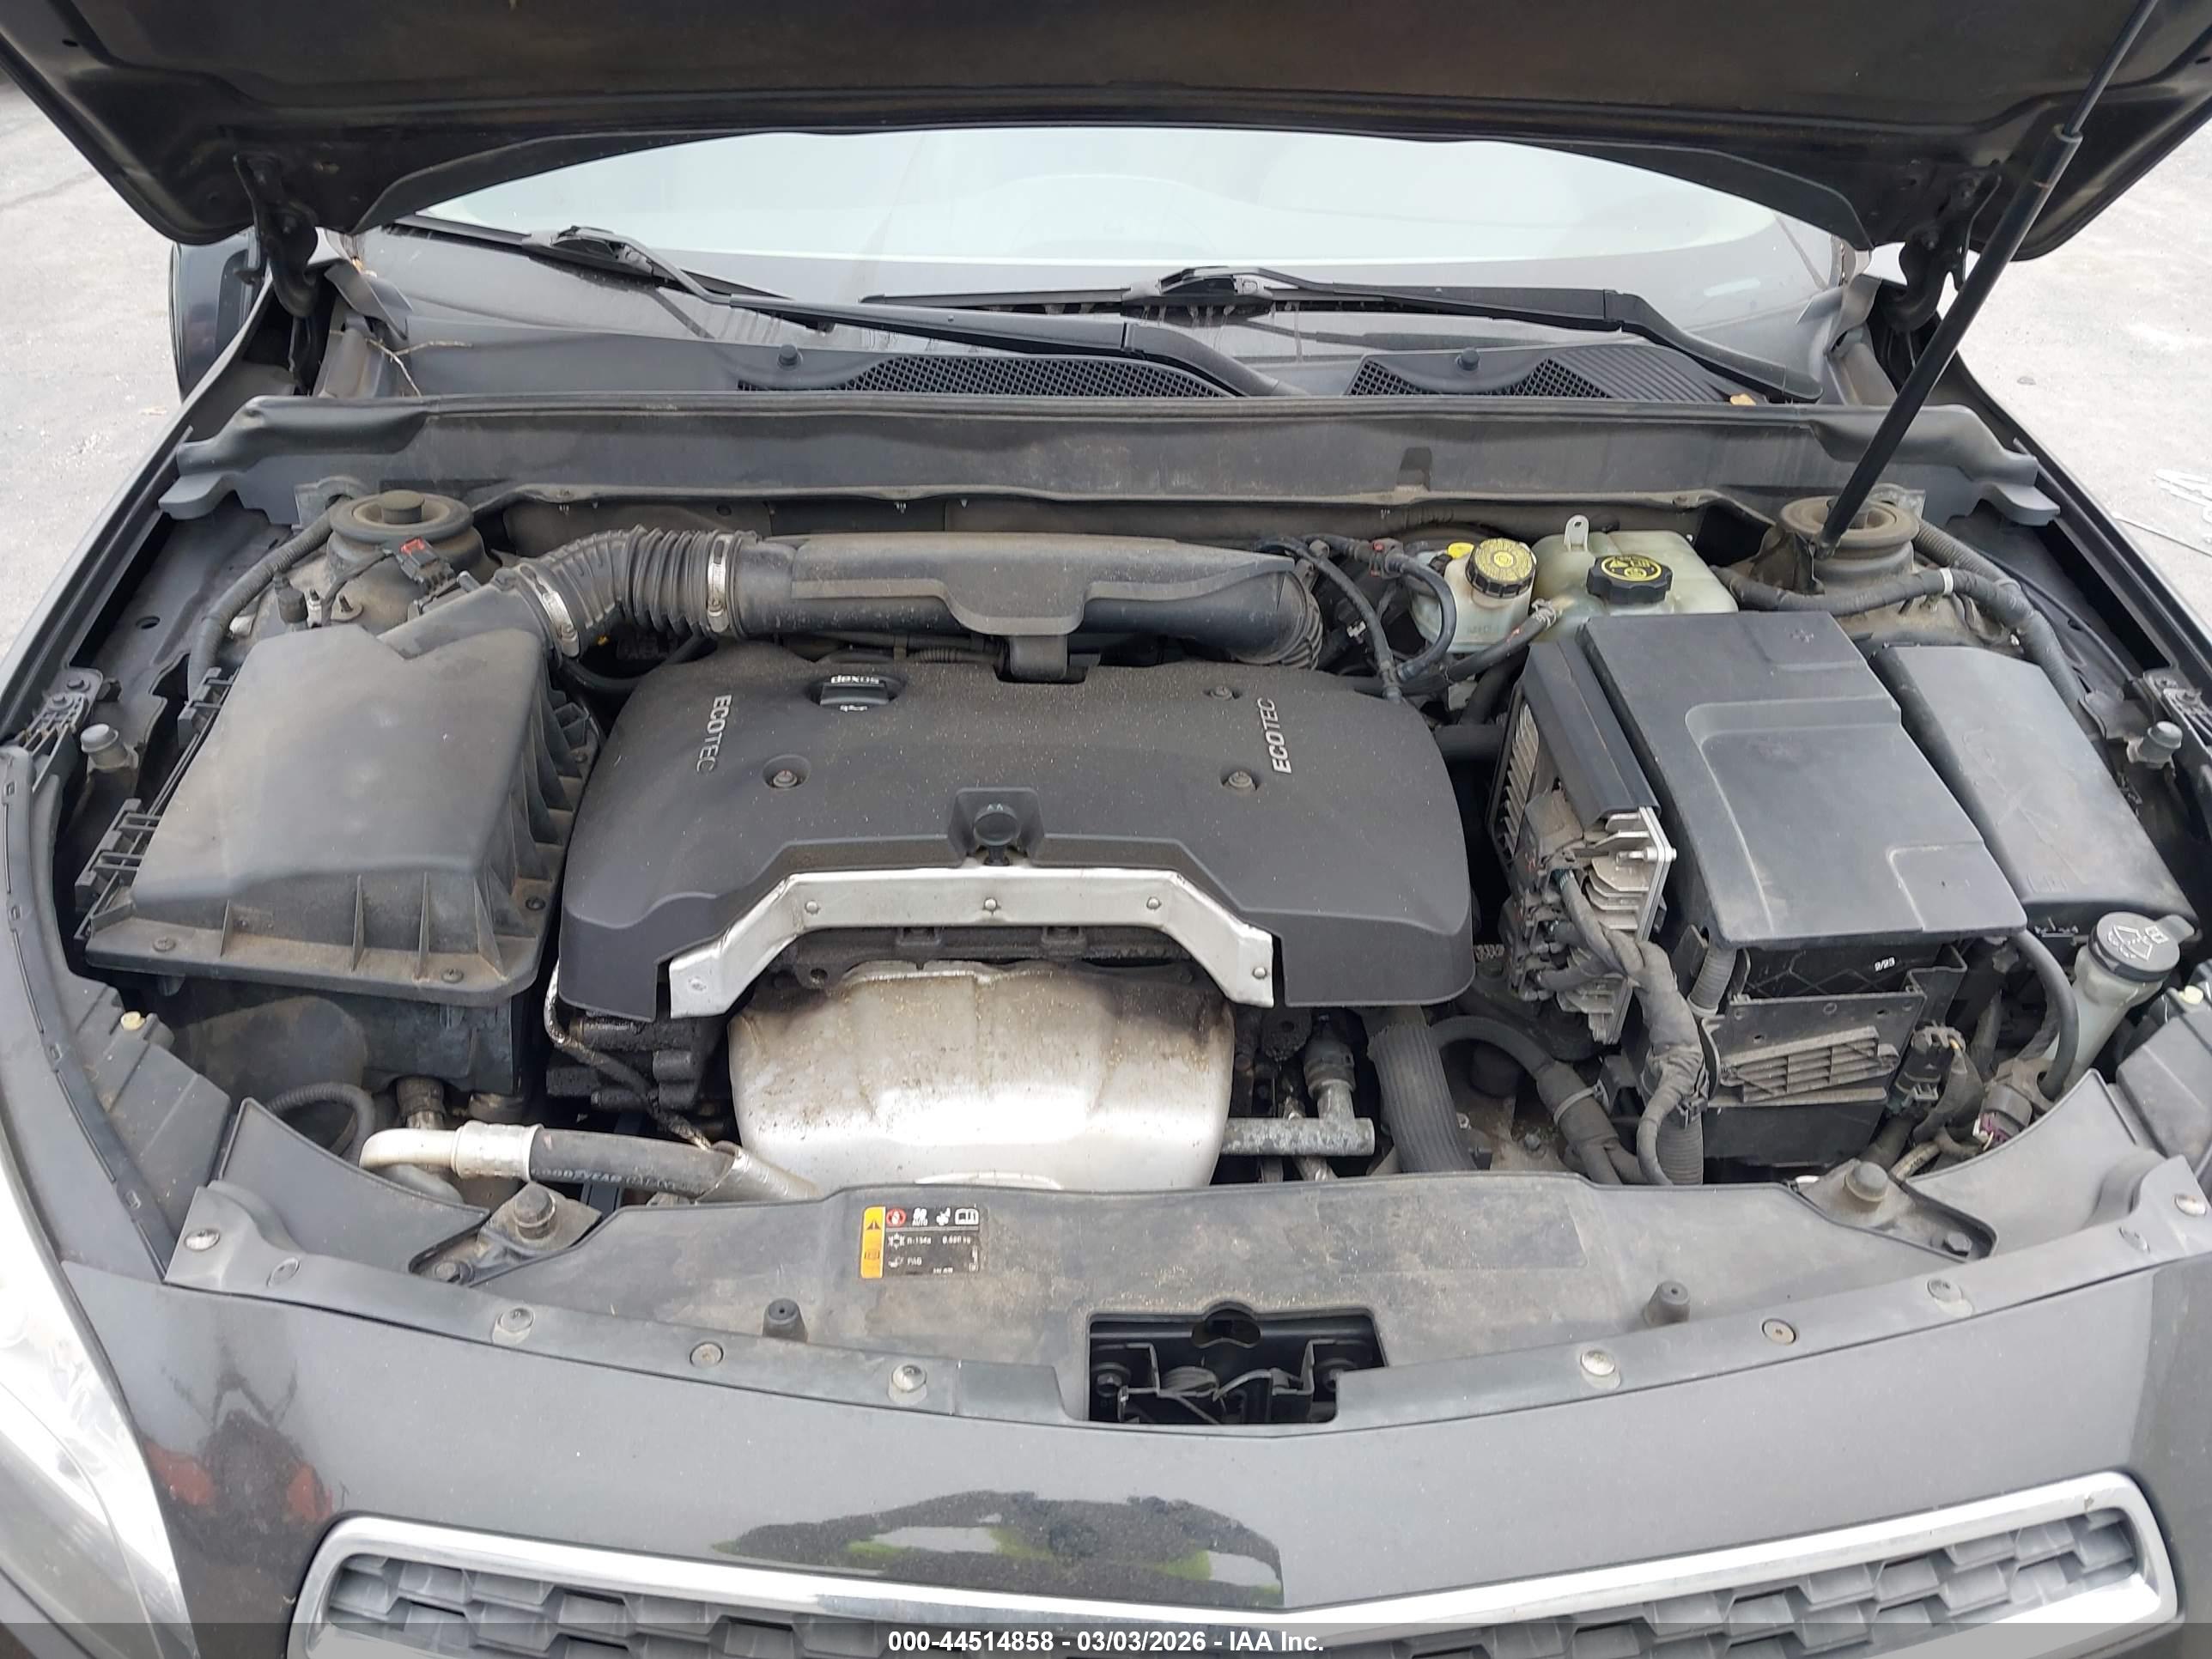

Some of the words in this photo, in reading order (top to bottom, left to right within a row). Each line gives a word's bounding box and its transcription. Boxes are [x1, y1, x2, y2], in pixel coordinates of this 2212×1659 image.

[830, 674, 880, 684] dexos
[696, 694, 732, 773] ECOTEC
[1256, 696, 1292, 774] ECOTEC
